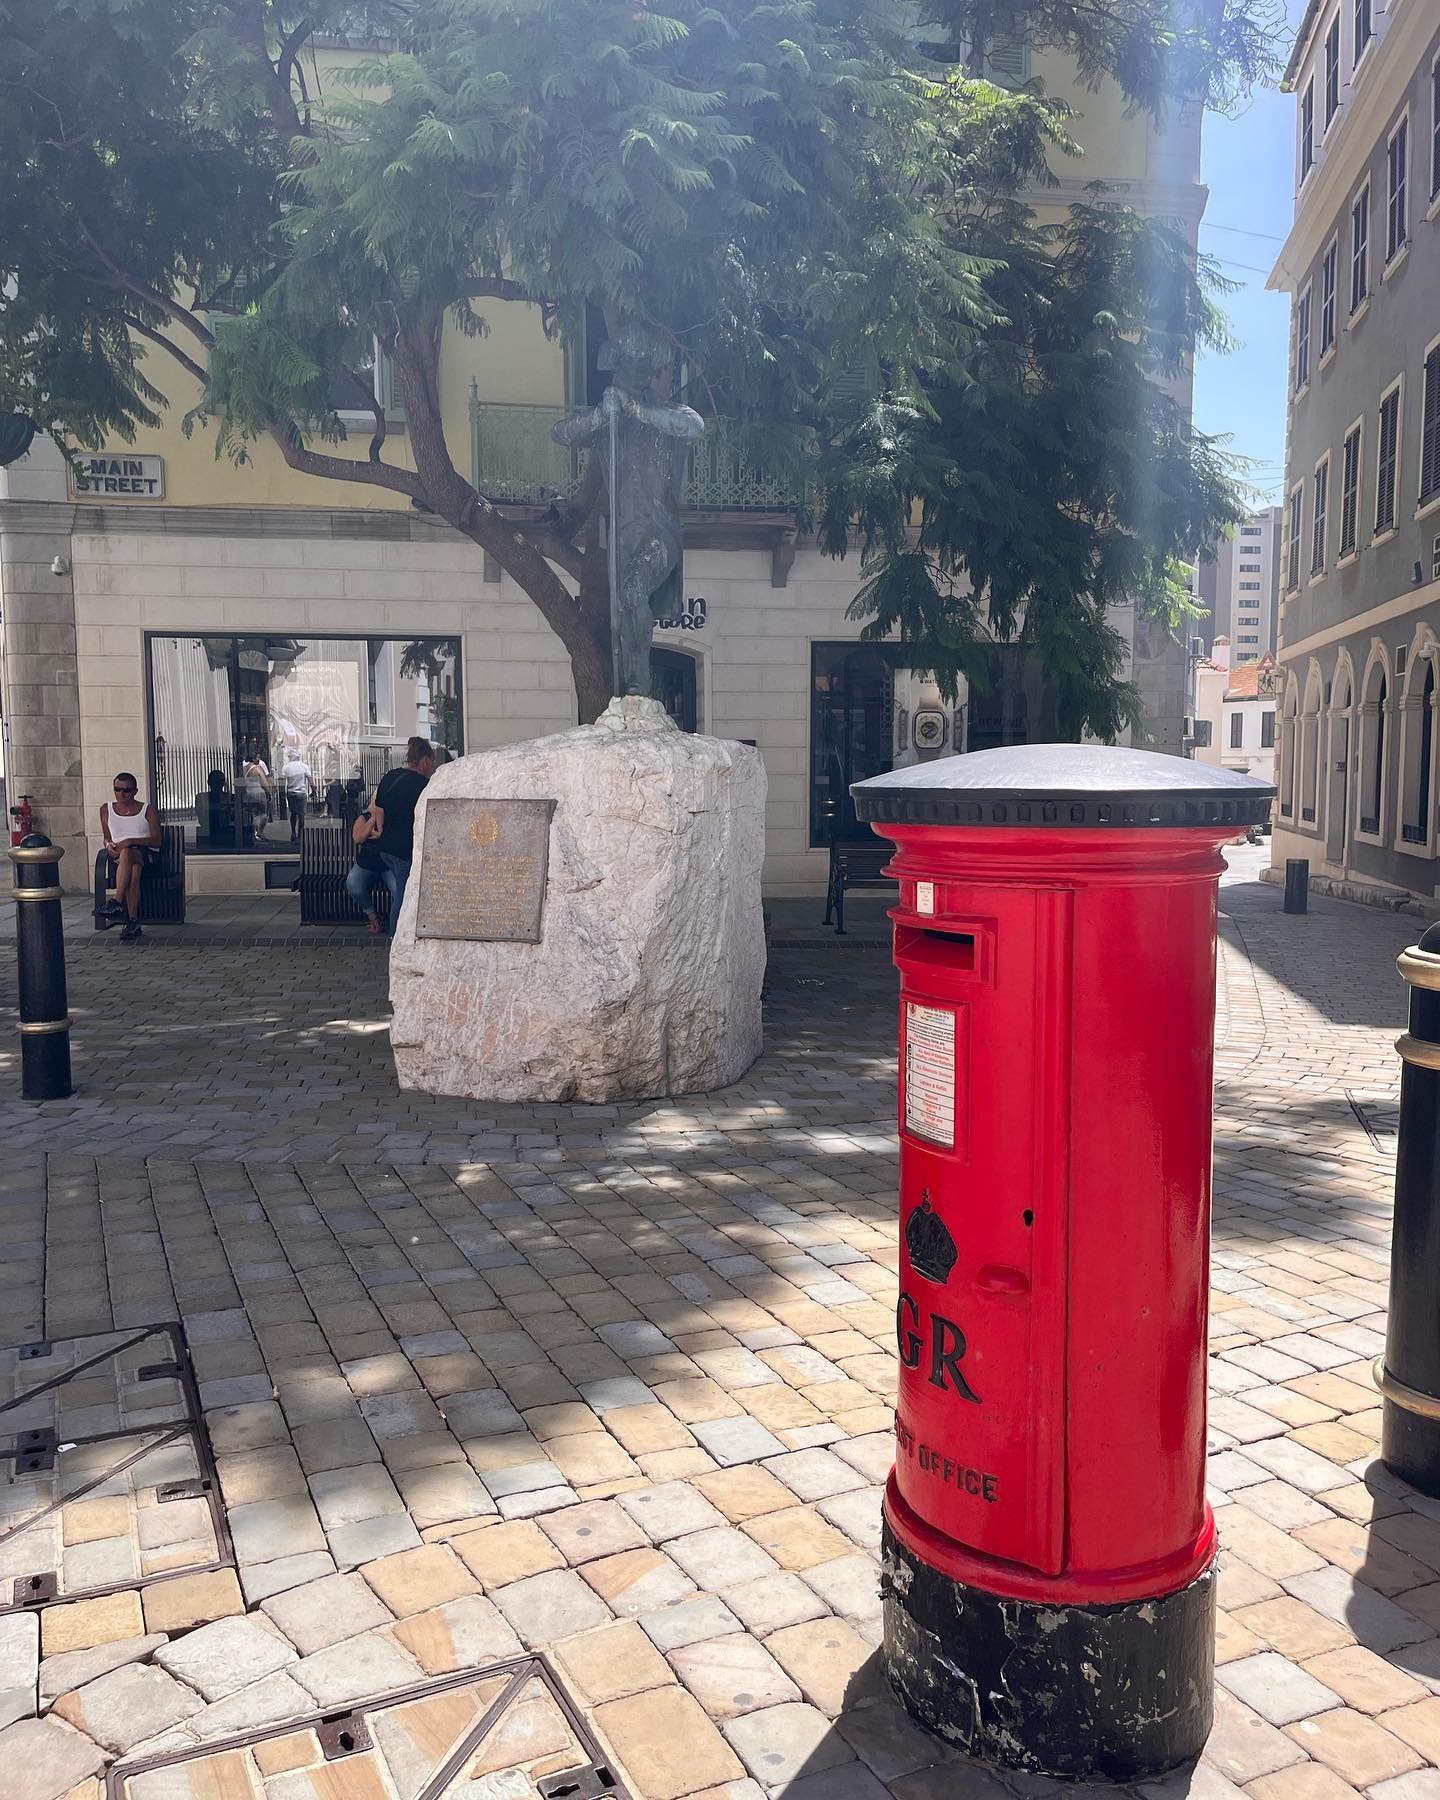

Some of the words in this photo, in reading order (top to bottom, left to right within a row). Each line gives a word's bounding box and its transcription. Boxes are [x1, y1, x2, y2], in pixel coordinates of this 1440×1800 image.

[90, 459, 143, 476] MAIN
[897, 1292, 984, 1405] GR
[918, 1444, 999, 1504] OFFICE
